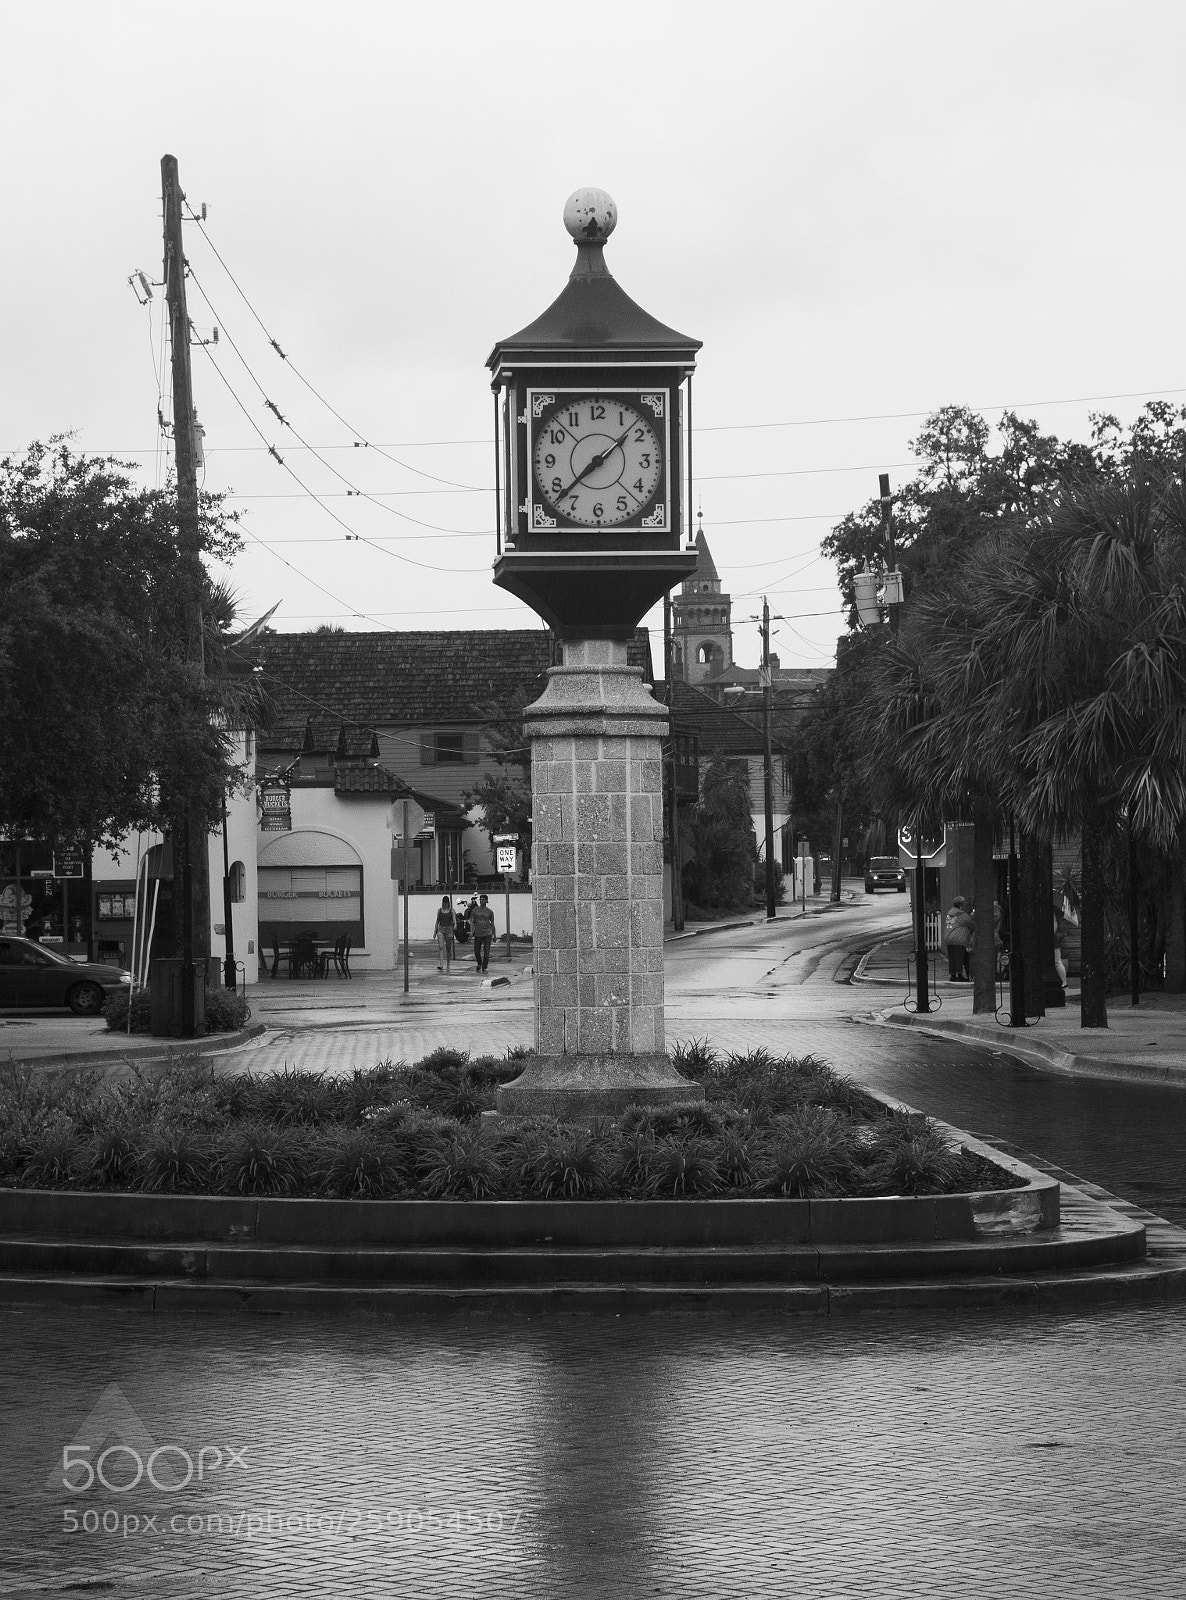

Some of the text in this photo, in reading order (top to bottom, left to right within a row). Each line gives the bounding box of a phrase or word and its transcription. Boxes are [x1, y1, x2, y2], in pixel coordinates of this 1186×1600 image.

[568, 412, 580, 427] 11
[590, 405, 606, 421] 12
[618, 411, 624, 426] 1
[549, 429, 566, 445] 10
[634, 428, 645, 443] 2
[544, 453, 556, 469] 9
[638, 453, 651, 469] 3
[551, 477, 563, 493] 8
[632, 477, 644, 493] 4
[568, 495, 580, 511] 7
[592, 503, 604, 518] 6
[616, 496, 628, 512] 5
[267, 889, 351, 898] BURGER BUCKETS
